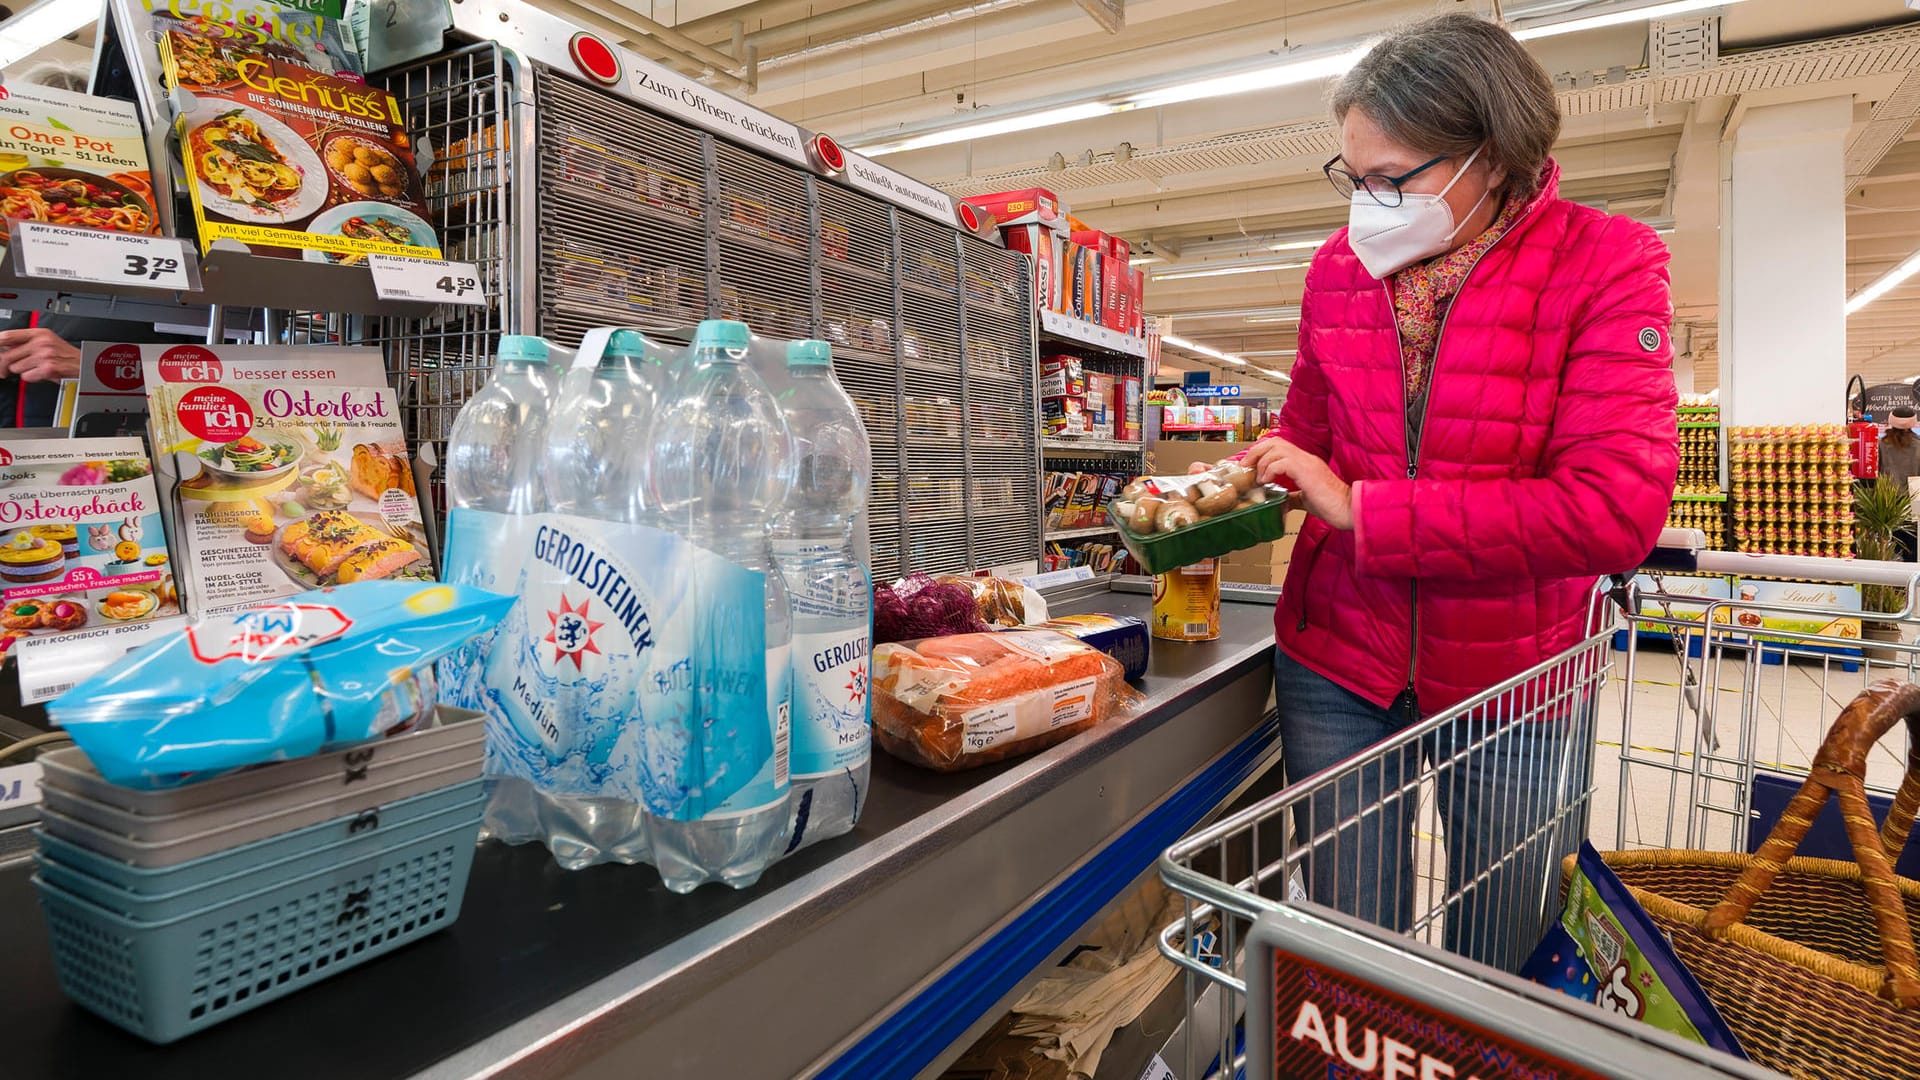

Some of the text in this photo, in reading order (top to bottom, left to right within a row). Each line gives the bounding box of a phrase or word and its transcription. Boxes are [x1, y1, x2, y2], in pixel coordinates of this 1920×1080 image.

[237, 59, 386, 121] Genuss
[248, 92, 266, 104] DIE
[268, 97, 342, 122] SONNENKÜCHE
[344, 116, 389, 133] SIZILIENS
[636, 70, 797, 150] Zum Öffnen: drücken!
[10, 126, 115, 154] One Pot
[20, 142, 56, 156] Topf
[76, 151, 94, 162] 51
[96, 154, 139, 168] Ideen
[1008, 203, 1022, 212] 250
[53, 228, 110, 240] KOCHBUCH
[116, 236, 150, 244] BOOKS
[218, 224, 238, 234] Mit
[242, 227, 260, 236] viel
[350, 239, 378, 250] Fisch
[380, 244, 398, 252] und
[400, 246, 434, 256] Fleisch
[1039, 264, 1049, 309] West
[1074, 258, 1084, 319] Columbus
[233, 368, 336, 380] besser essen
[178, 402, 220, 411] Familie
[193, 395, 226, 403] meine
[264, 388, 389, 420] Osterfest
[204, 404, 251, 428] ich
[256, 416, 275, 428] 34
[2, 470, 36, 481] books
[9, 486, 128, 500] Süße Überraschungen
[0, 492, 145, 524] Ostergebäck
[200, 546, 270, 556] GESCHNETZELTES
[72, 570, 94, 582] 55 x
[90, 577, 120, 586] Freude
[122, 574, 156, 583] machen
[217, 578, 262, 588] ASIA-STYLE
[535, 525, 654, 657] GEROLSTEINER
[1784, 589, 1825, 602] Lindt
[50, 630, 110, 644] KOCHBUCH
[115, 624, 150, 634] BOOKS
[512, 674, 561, 745] Medium
[968, 736, 984, 748] 1kg
